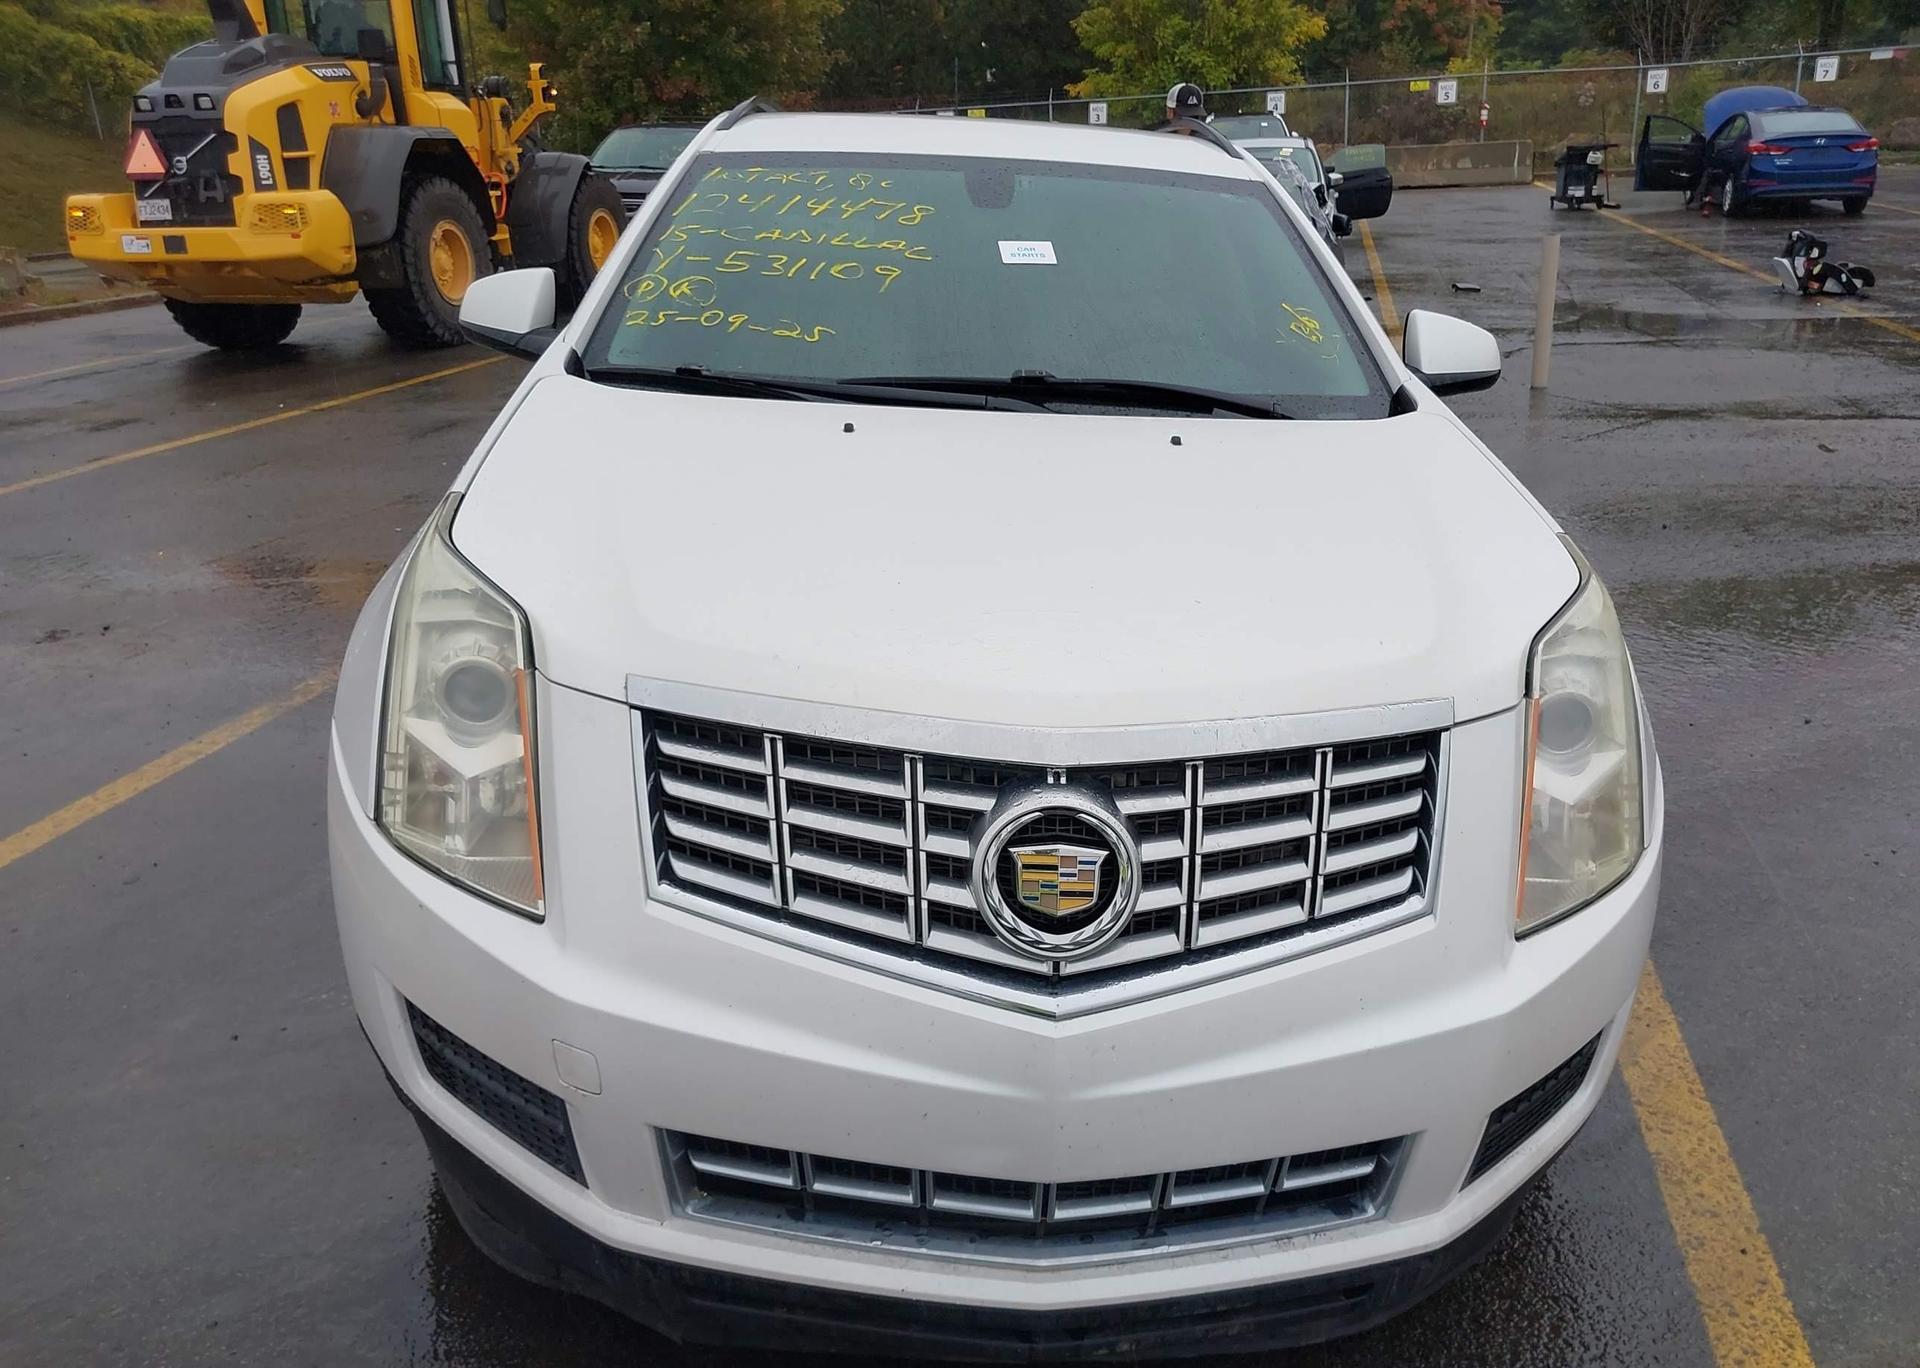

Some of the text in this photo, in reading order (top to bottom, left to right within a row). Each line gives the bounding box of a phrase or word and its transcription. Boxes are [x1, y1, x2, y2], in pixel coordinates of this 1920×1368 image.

[311, 67, 351, 78] VOLVO
[1822, 69, 1829, 79] 7
[1653, 80, 1660, 90] 6
[1443, 91, 1450, 101] 5
[1272, 103, 1278, 112] 4
[1094, 113, 1100, 122] 3
[255, 154, 274, 185] L90H
[672, 193, 935, 225] 12414478
[625, 310, 836, 342] 25-09-25
